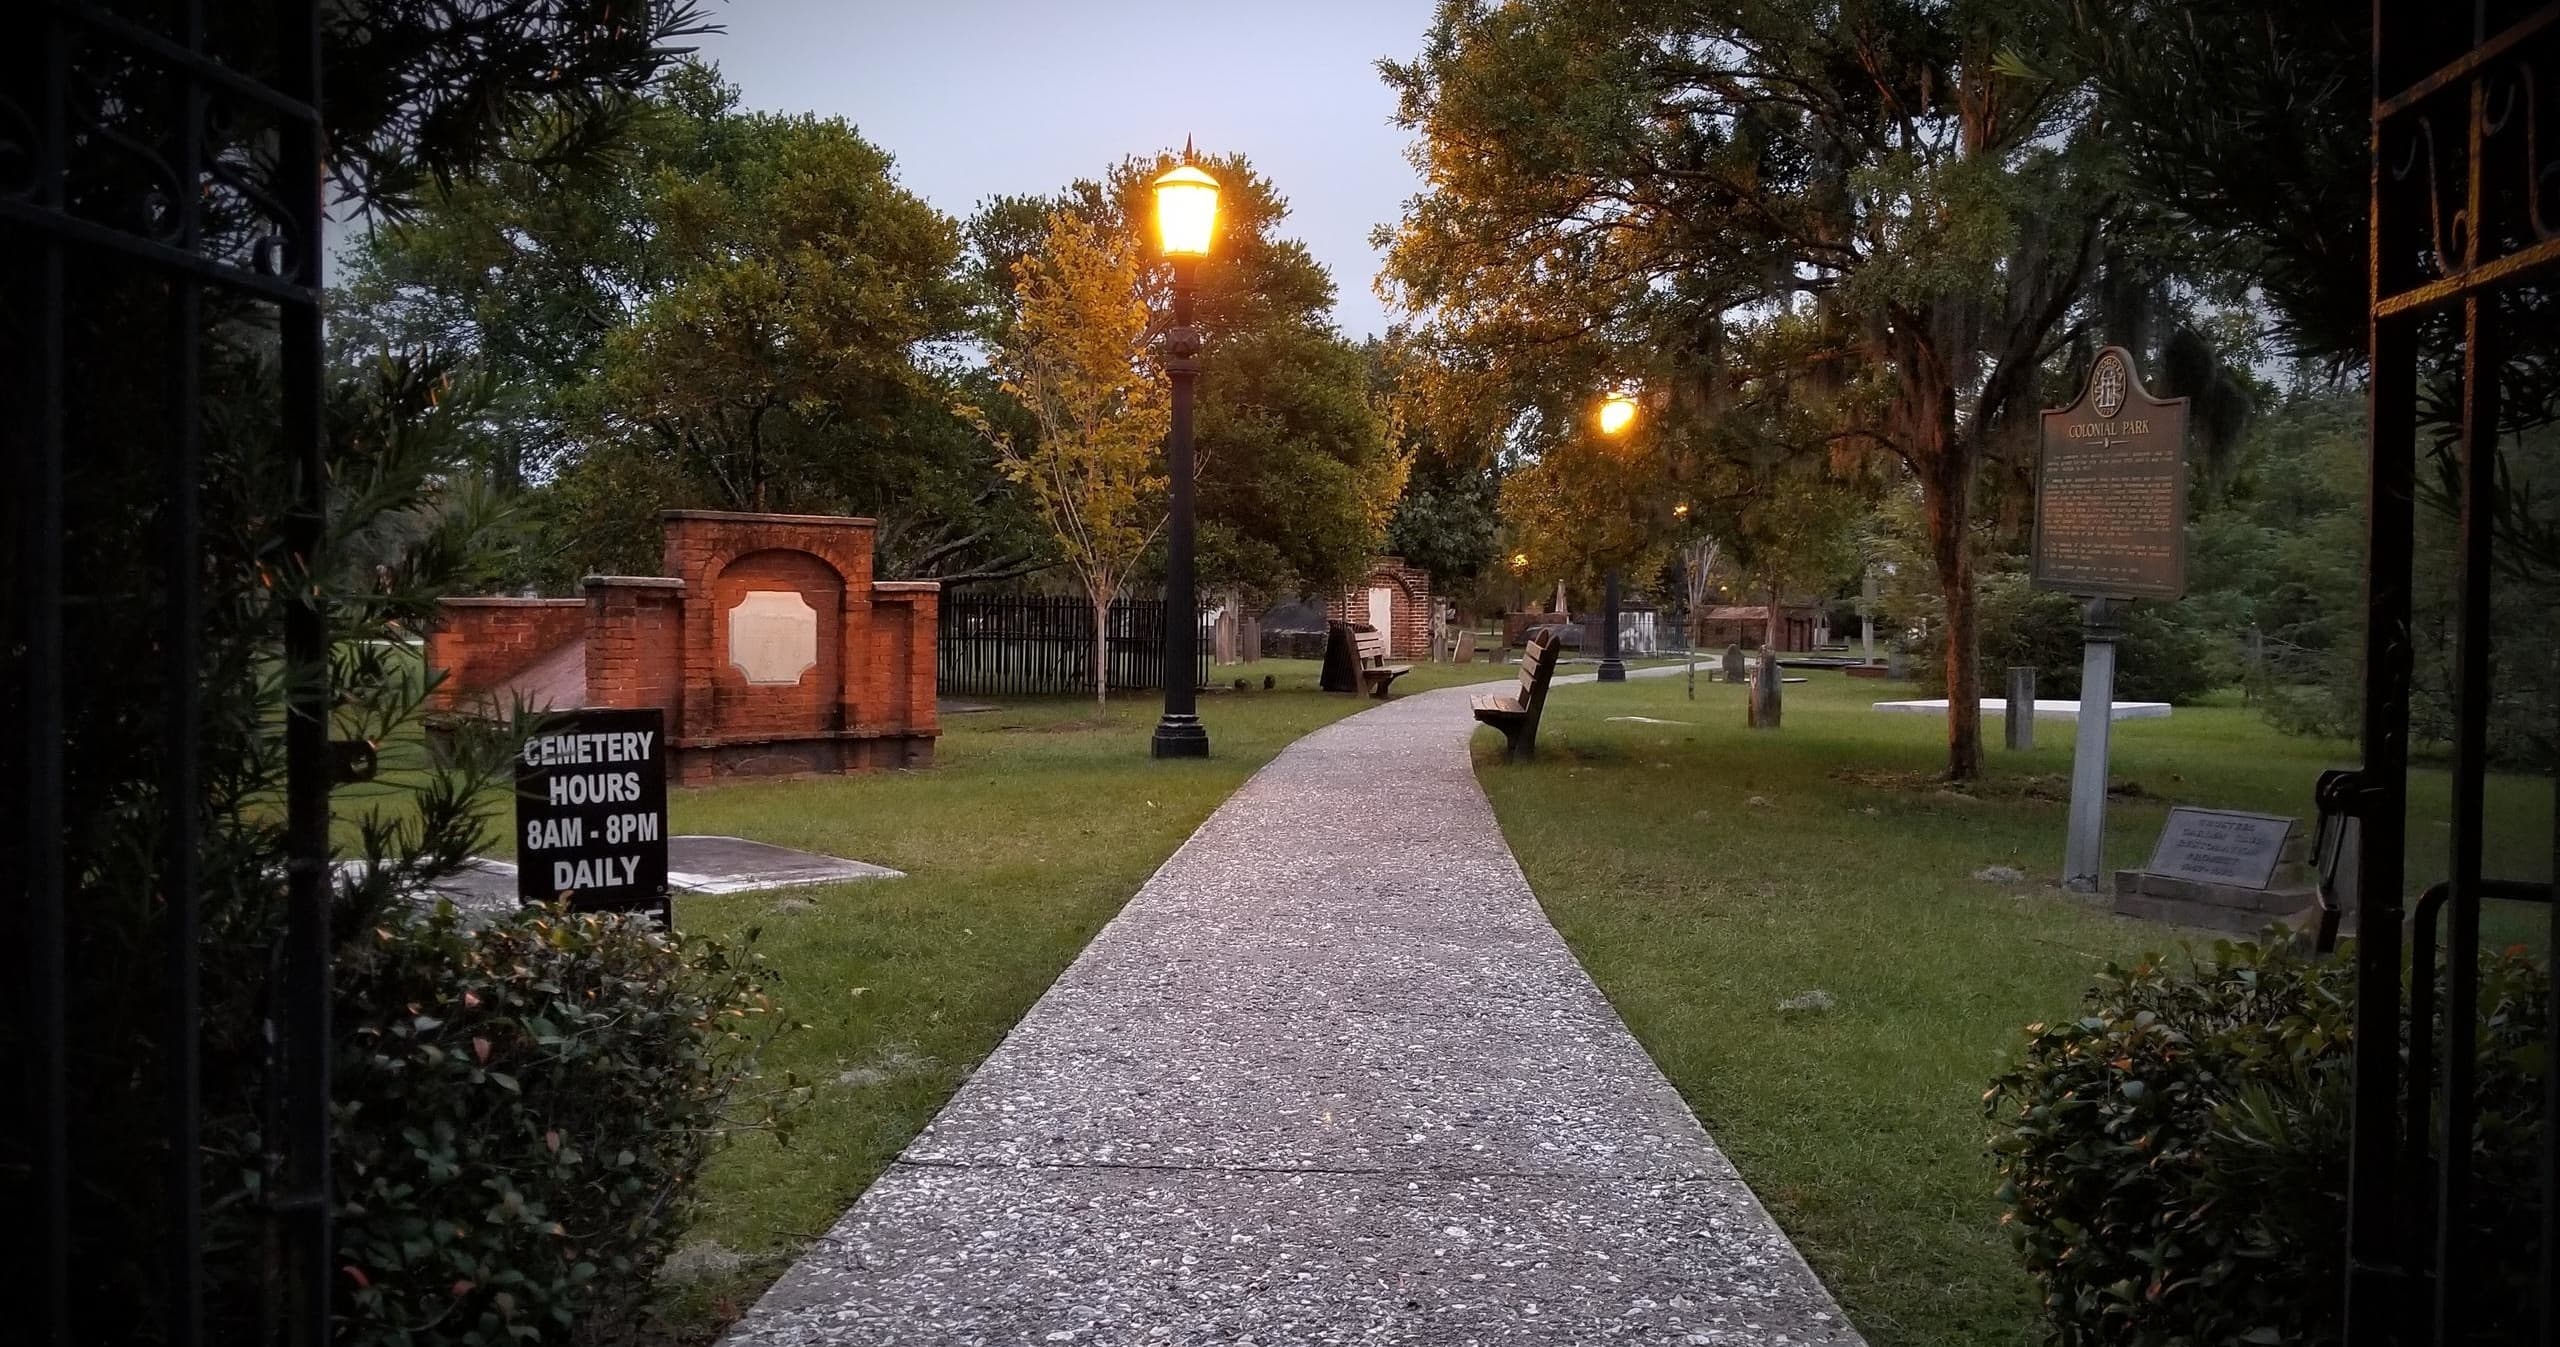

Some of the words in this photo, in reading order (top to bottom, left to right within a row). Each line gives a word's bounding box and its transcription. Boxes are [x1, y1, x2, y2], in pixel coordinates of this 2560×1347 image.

[2069, 422, 2118, 438] COLONIAL
[2122, 420, 2150, 435] PARK
[524, 732, 654, 766] CEMETERY
[550, 772, 640, 806] HOURS
[527, 817, 583, 850] 8AM
[590, 831, 599, 839] -
[606, 813, 658, 844] 8PM
[554, 856, 641, 890] DAILY
